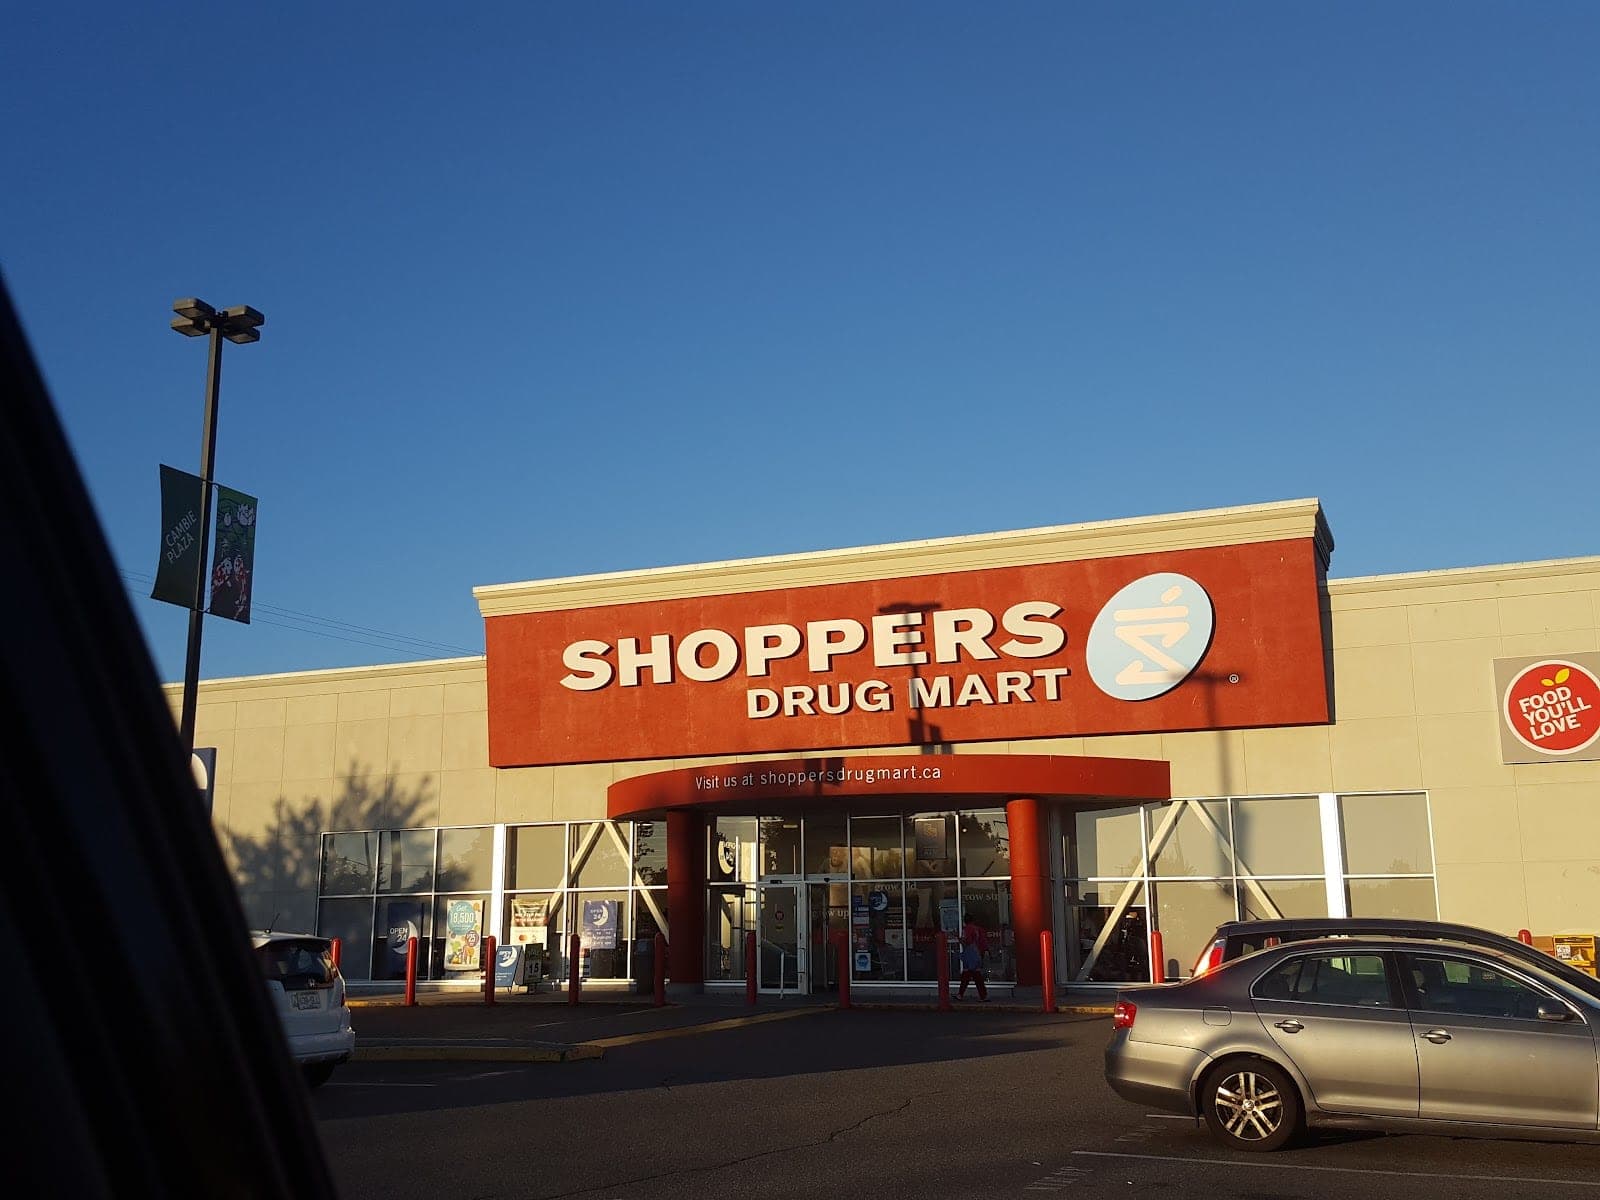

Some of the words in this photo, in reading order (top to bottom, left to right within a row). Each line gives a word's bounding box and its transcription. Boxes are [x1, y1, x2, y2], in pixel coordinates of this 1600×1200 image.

[165, 510, 197, 547] CAMBIE
[166, 533, 195, 564] PLAZA
[560, 600, 1067, 692] SHOPPERS
[746, 680, 892, 719] DRUG
[909, 667, 1069, 709] MART
[1518, 686, 1572, 713] FOOD
[1523, 696, 1592, 726] YOU'LL
[1530, 714, 1580, 739] LOVE
[695, 775, 719, 790] Visit
[723, 776, 737, 788] us
[742, 771, 754, 786] at
[760, 765, 941, 785] shoppersdrugmart.ca
[389, 927, 408, 935] OPEN
[397, 934, 407, 943] 24
[529, 963, 539, 973] 15
